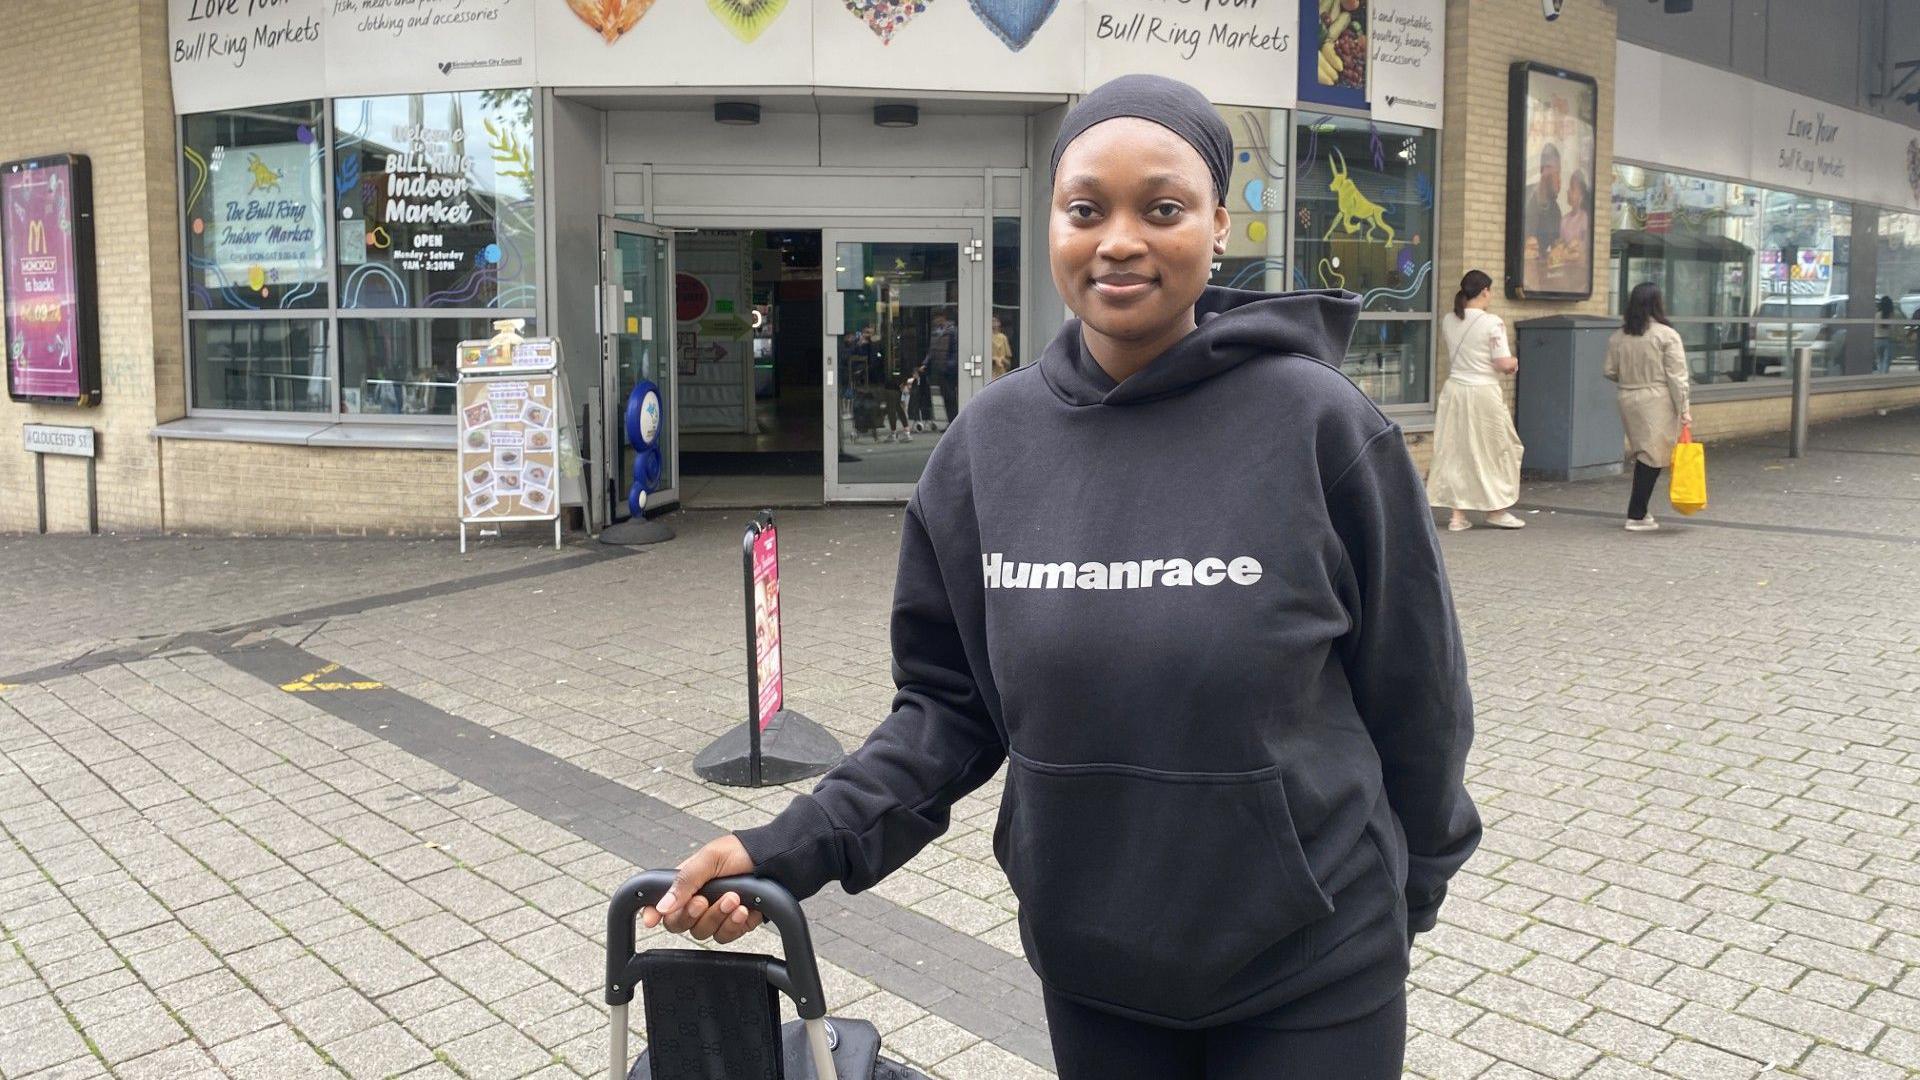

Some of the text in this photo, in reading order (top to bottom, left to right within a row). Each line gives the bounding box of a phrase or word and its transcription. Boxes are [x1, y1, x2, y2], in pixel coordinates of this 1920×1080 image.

[187, 0, 240, 21] Love
[357, 8, 499, 37] clothing and accessories
[174, 16, 320, 68] Bull Ring Markets
[1096, 13, 1290, 60] Bull Ring Markets
[385, 150, 473, 174] BULL RING
[387, 173, 470, 198] Indoor
[246, 200, 276, 221] Bull
[385, 199, 473, 224] Market
[413, 234, 443, 248] OPEN
[393, 250, 424, 261] Monday
[429, 250, 464, 261] Saturday
[32, 430, 76, 447] GLOUCESTER
[982, 553, 1264, 590] Humanrace
